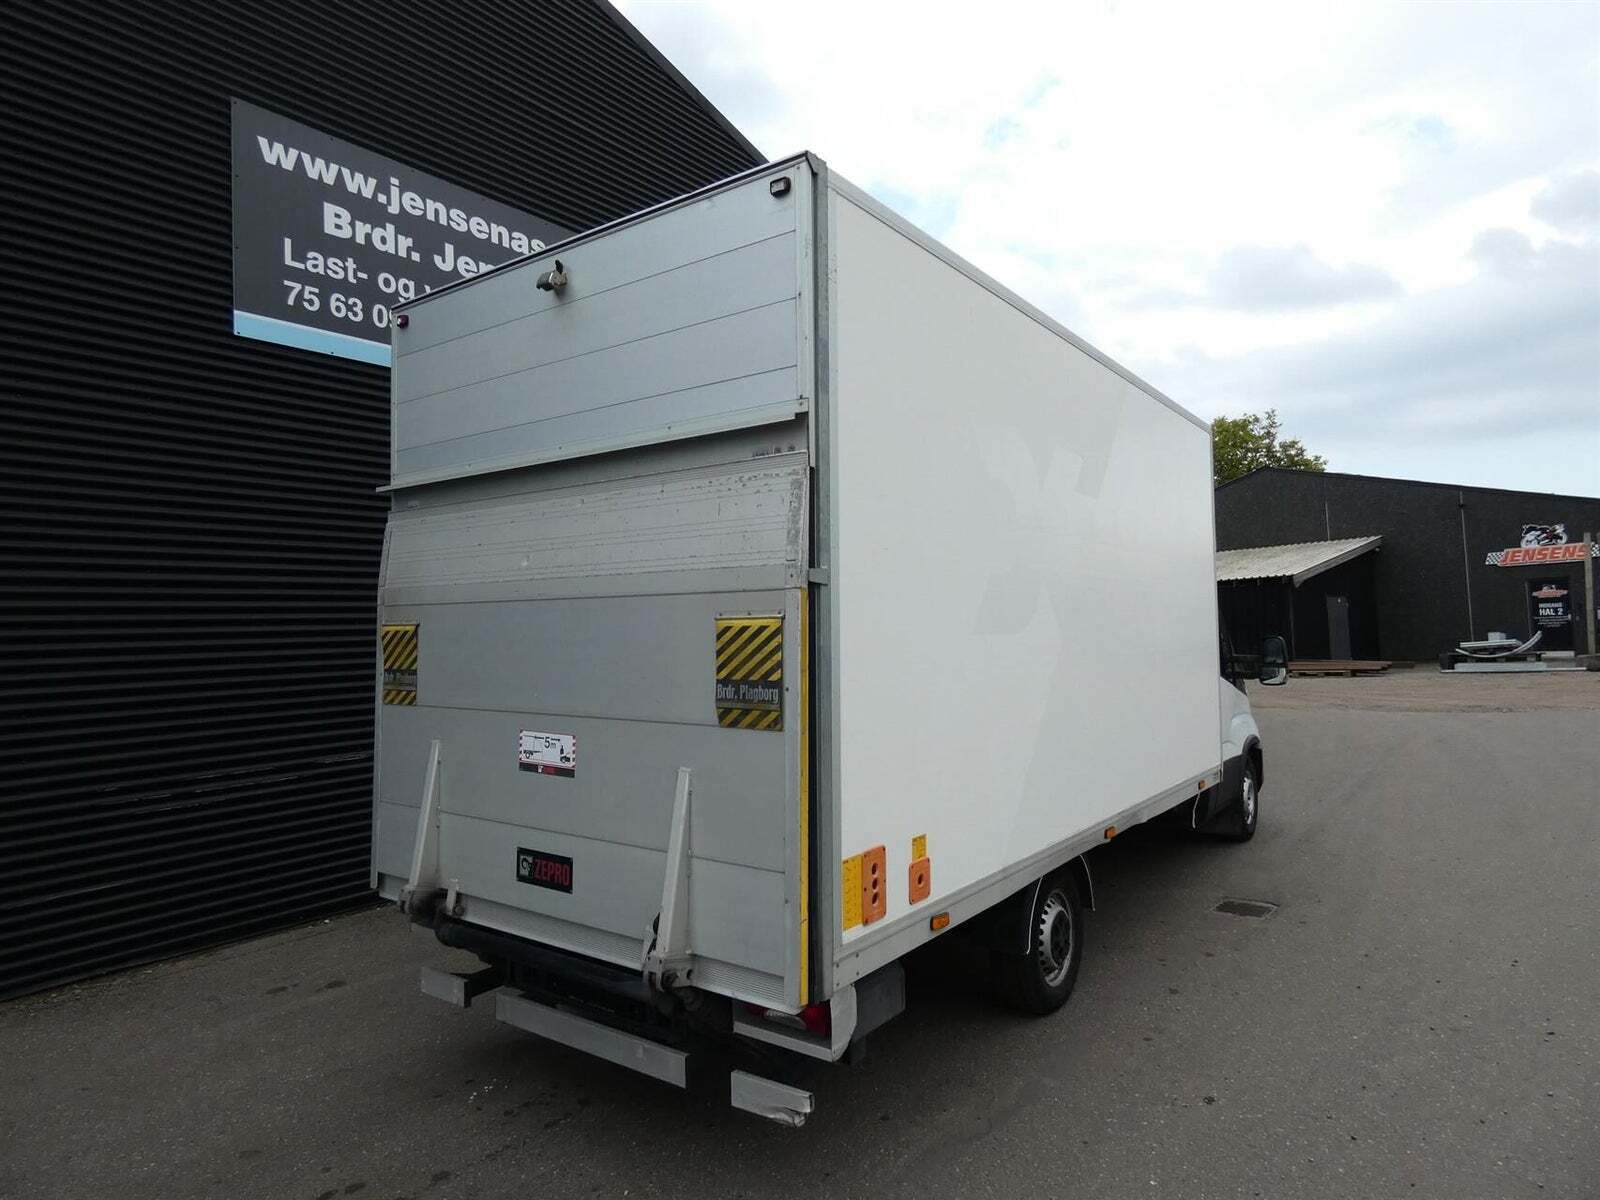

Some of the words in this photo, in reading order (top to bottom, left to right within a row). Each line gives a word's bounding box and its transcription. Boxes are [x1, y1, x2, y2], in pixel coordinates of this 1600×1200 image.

[323, 201, 421, 263] Brdr.
[283, 237, 368, 284] Last-
[377, 273, 416, 303] og
[282, 280, 321, 313] 75
[329, 291, 364, 323] 63
[372, 304, 393, 329] 0
[1539, 608, 1555, 616] HAL
[1557, 607, 1563, 615] 2
[717, 683, 738, 699] Brdr.
[534, 859, 570, 887] ZEPRO
